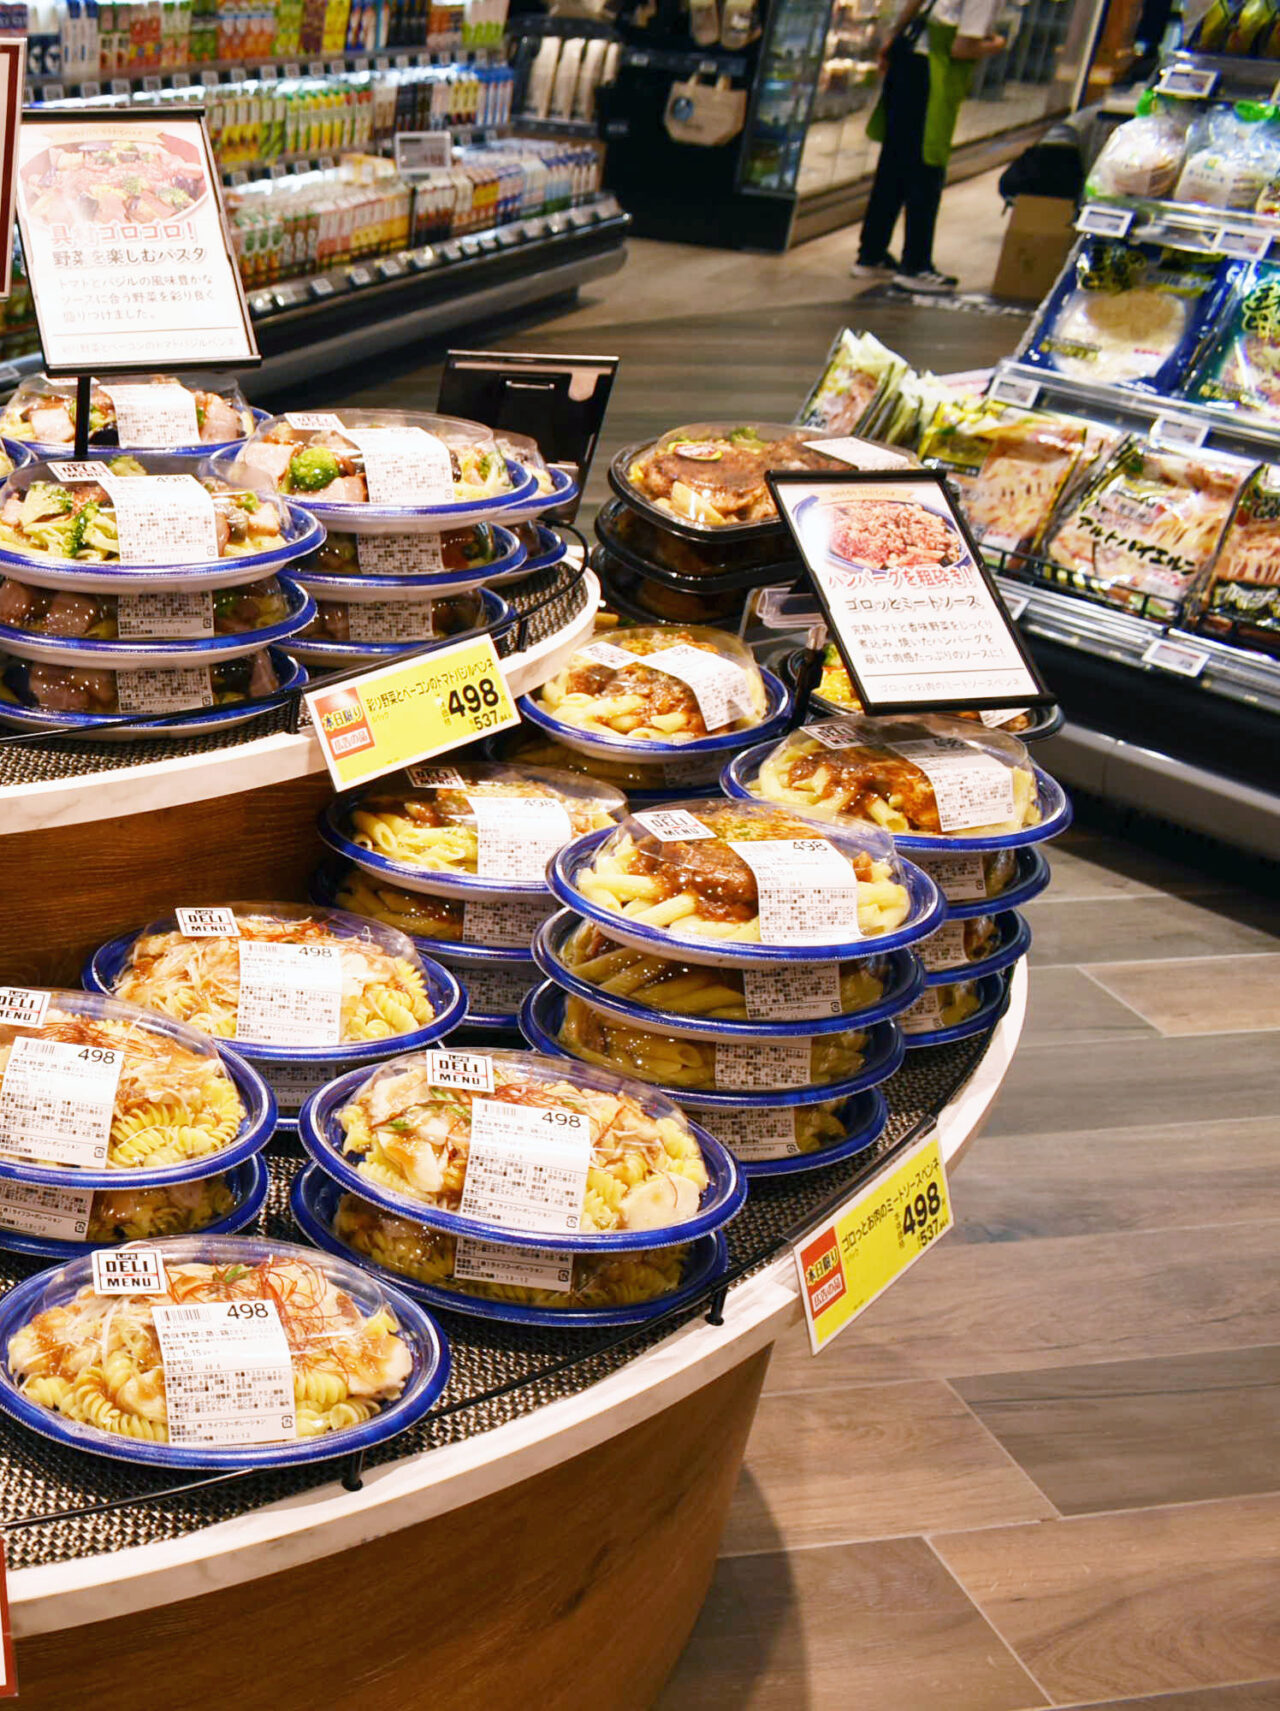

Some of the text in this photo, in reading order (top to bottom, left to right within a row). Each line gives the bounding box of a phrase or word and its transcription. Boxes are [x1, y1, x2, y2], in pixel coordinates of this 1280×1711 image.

[51, 221, 196, 245] 具ゴロゴロ!
[1076, 515, 1197, 577] アルトバイエルン
[448, 678, 499, 719] 498
[474, 710, 498, 731] 537
[792, 841, 828, 852] 498
[188, 914, 224, 923] DELI
[298, 946, 333, 959] 498
[78, 1048, 116, 1065] 498
[438, 1059, 480, 1074] DELI
[438, 1073, 481, 1086] MENU
[541, 1111, 582, 1128] 498
[903, 1181, 942, 1236] 498
[920, 1217, 939, 1247] 537
[105, 1260, 150, 1273] DELI
[107, 1277, 152, 1288] MENU
[226, 1302, 270, 1320] 498
